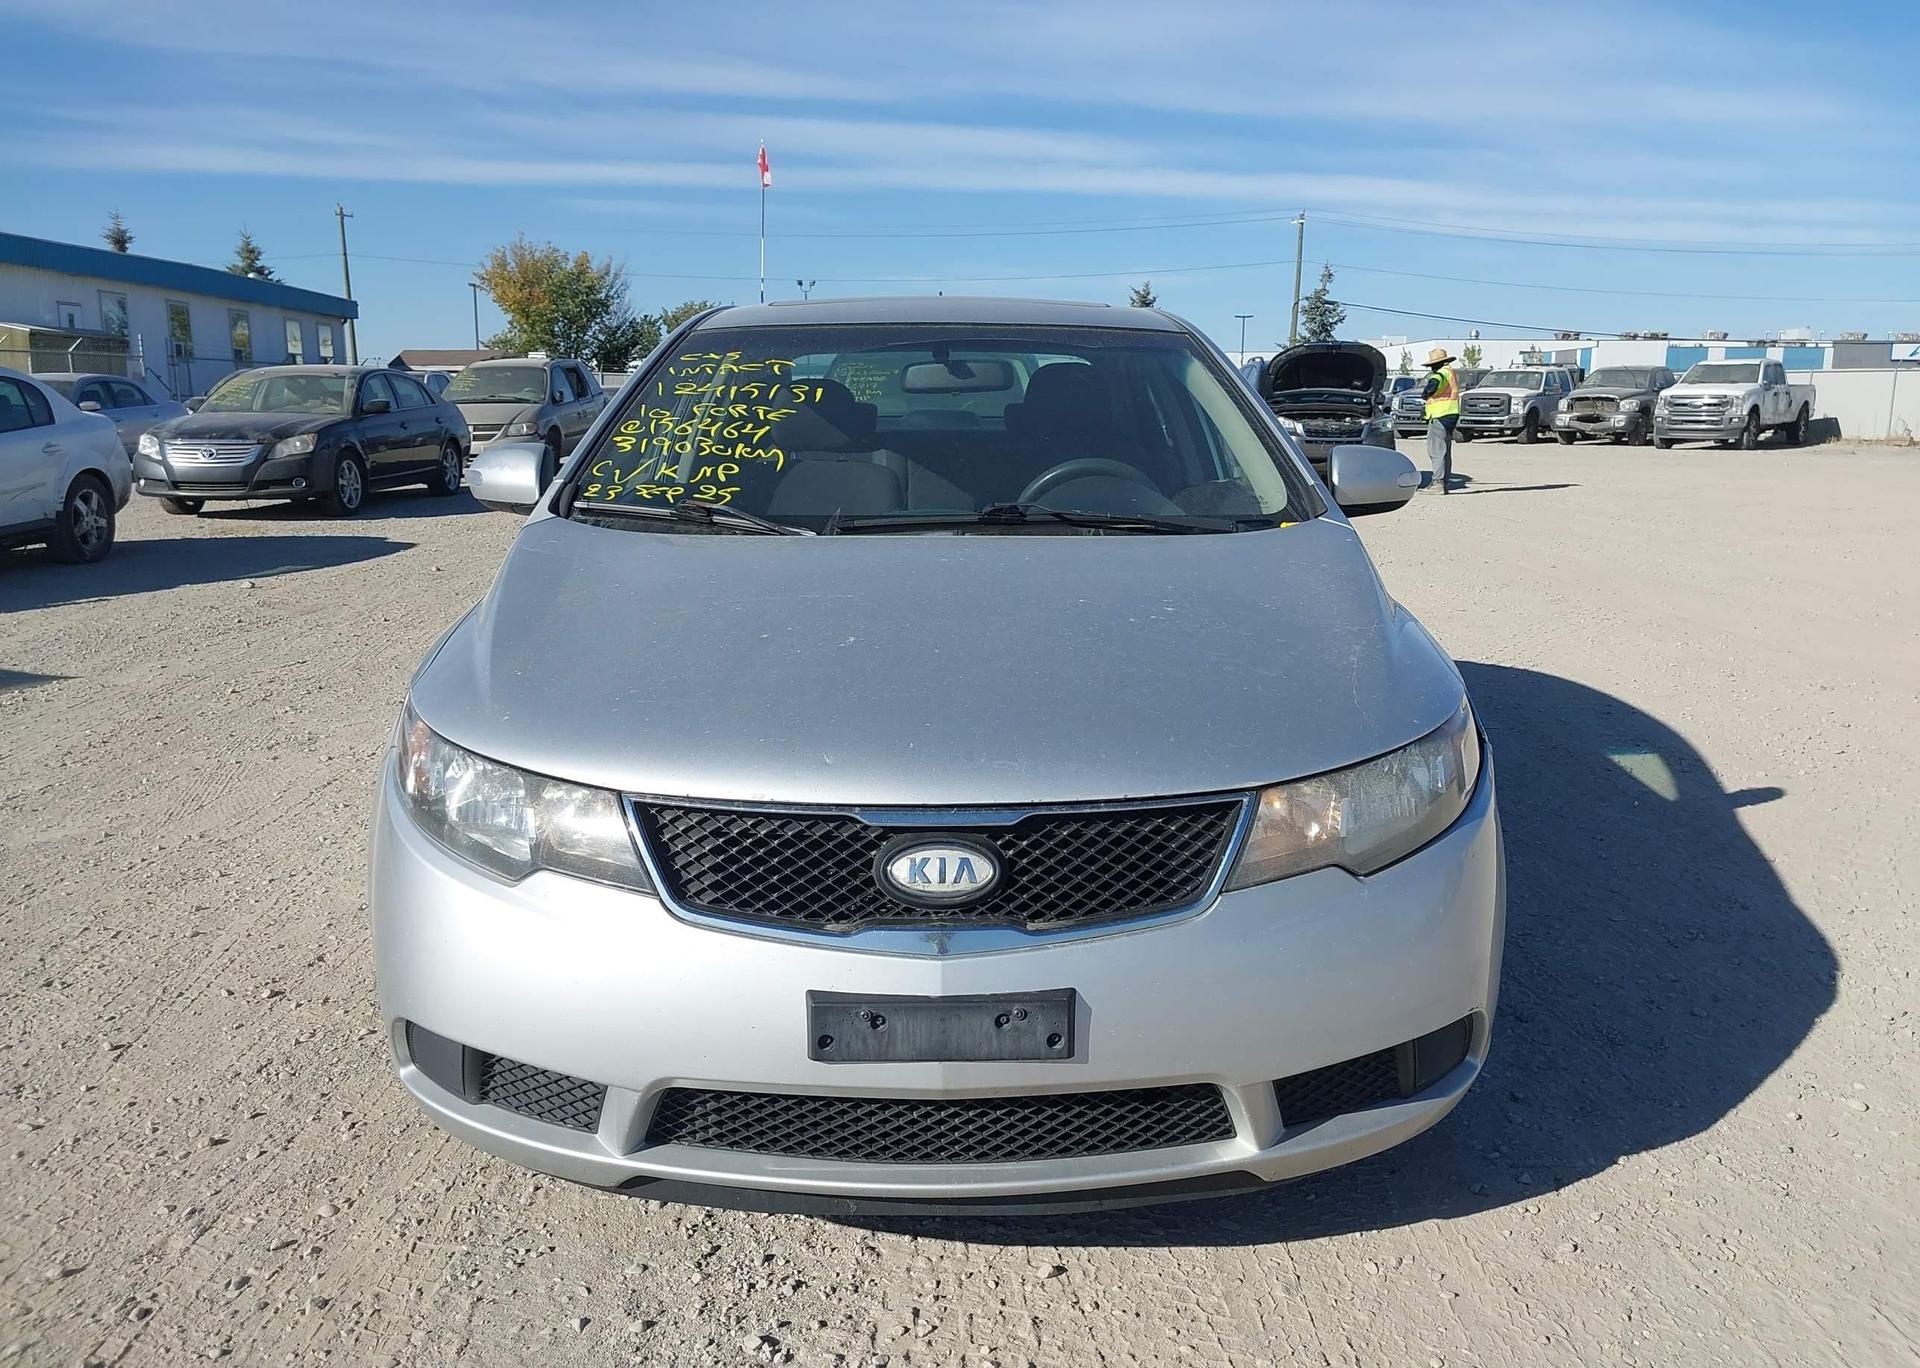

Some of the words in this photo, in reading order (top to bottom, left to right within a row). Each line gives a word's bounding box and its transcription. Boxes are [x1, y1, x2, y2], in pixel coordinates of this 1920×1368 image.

[668, 359, 797, 377] INTACT
[692, 403, 797, 421] FORTE
[692, 485, 741, 505] 25
[906, 856, 978, 885] KIA
